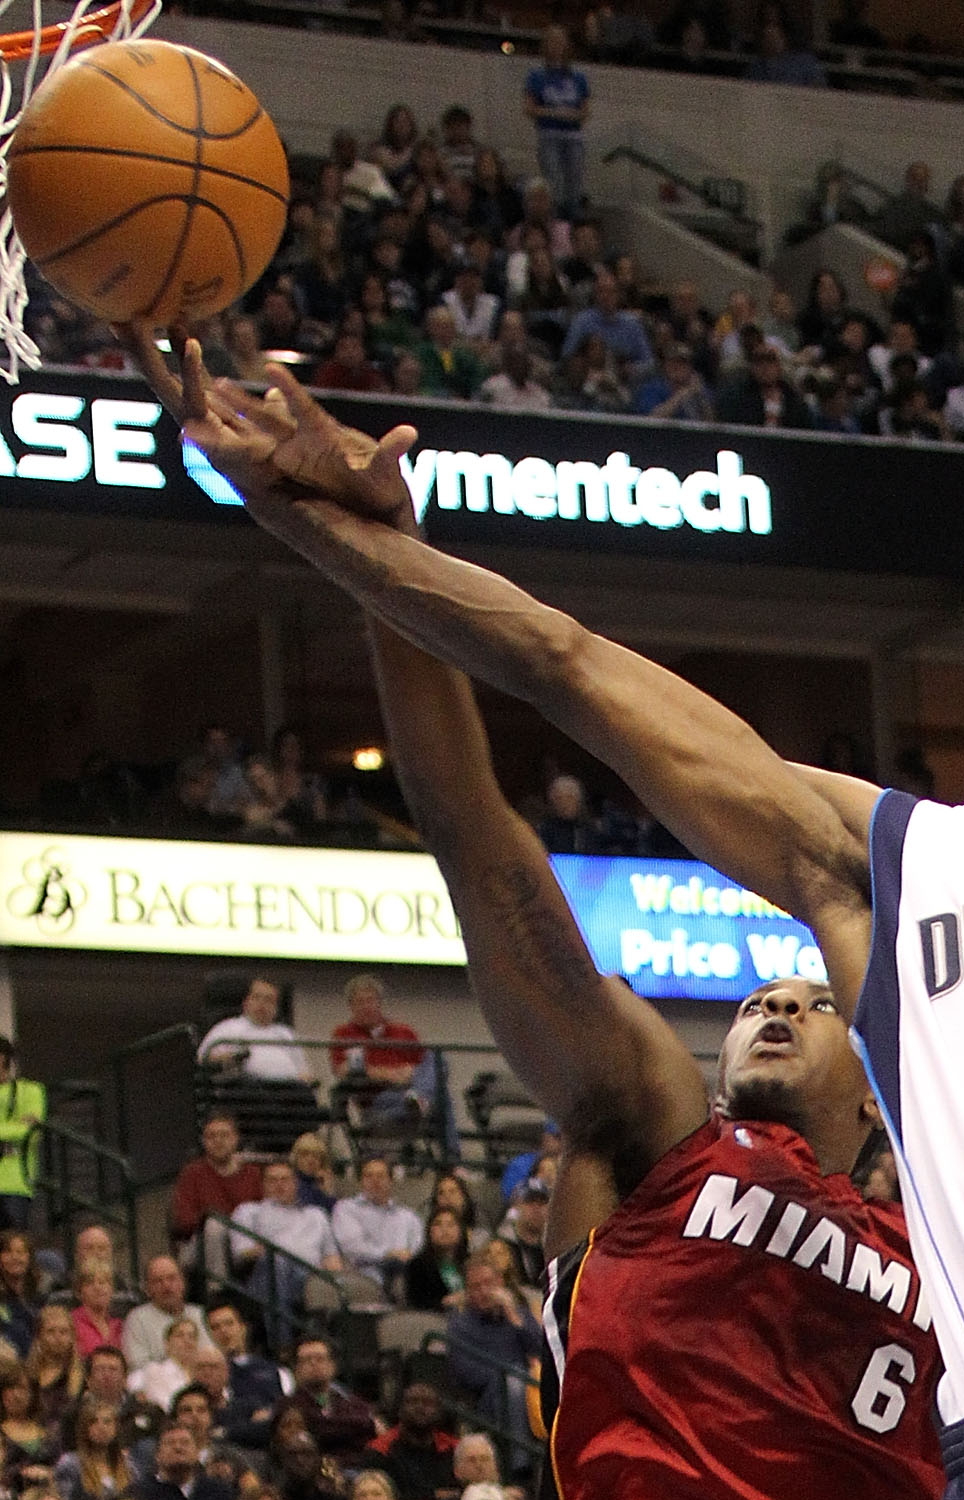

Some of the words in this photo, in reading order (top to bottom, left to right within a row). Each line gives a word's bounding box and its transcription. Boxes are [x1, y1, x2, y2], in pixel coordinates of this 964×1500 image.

[0, 392, 166, 489] SE
[399, 449, 773, 535] ymentech
[106, 868, 463, 939] BACHENDOR
[630, 873, 794, 919] Welcom
[621, 928, 740, 978] Price
[851, 1343, 916, 1434] 6
